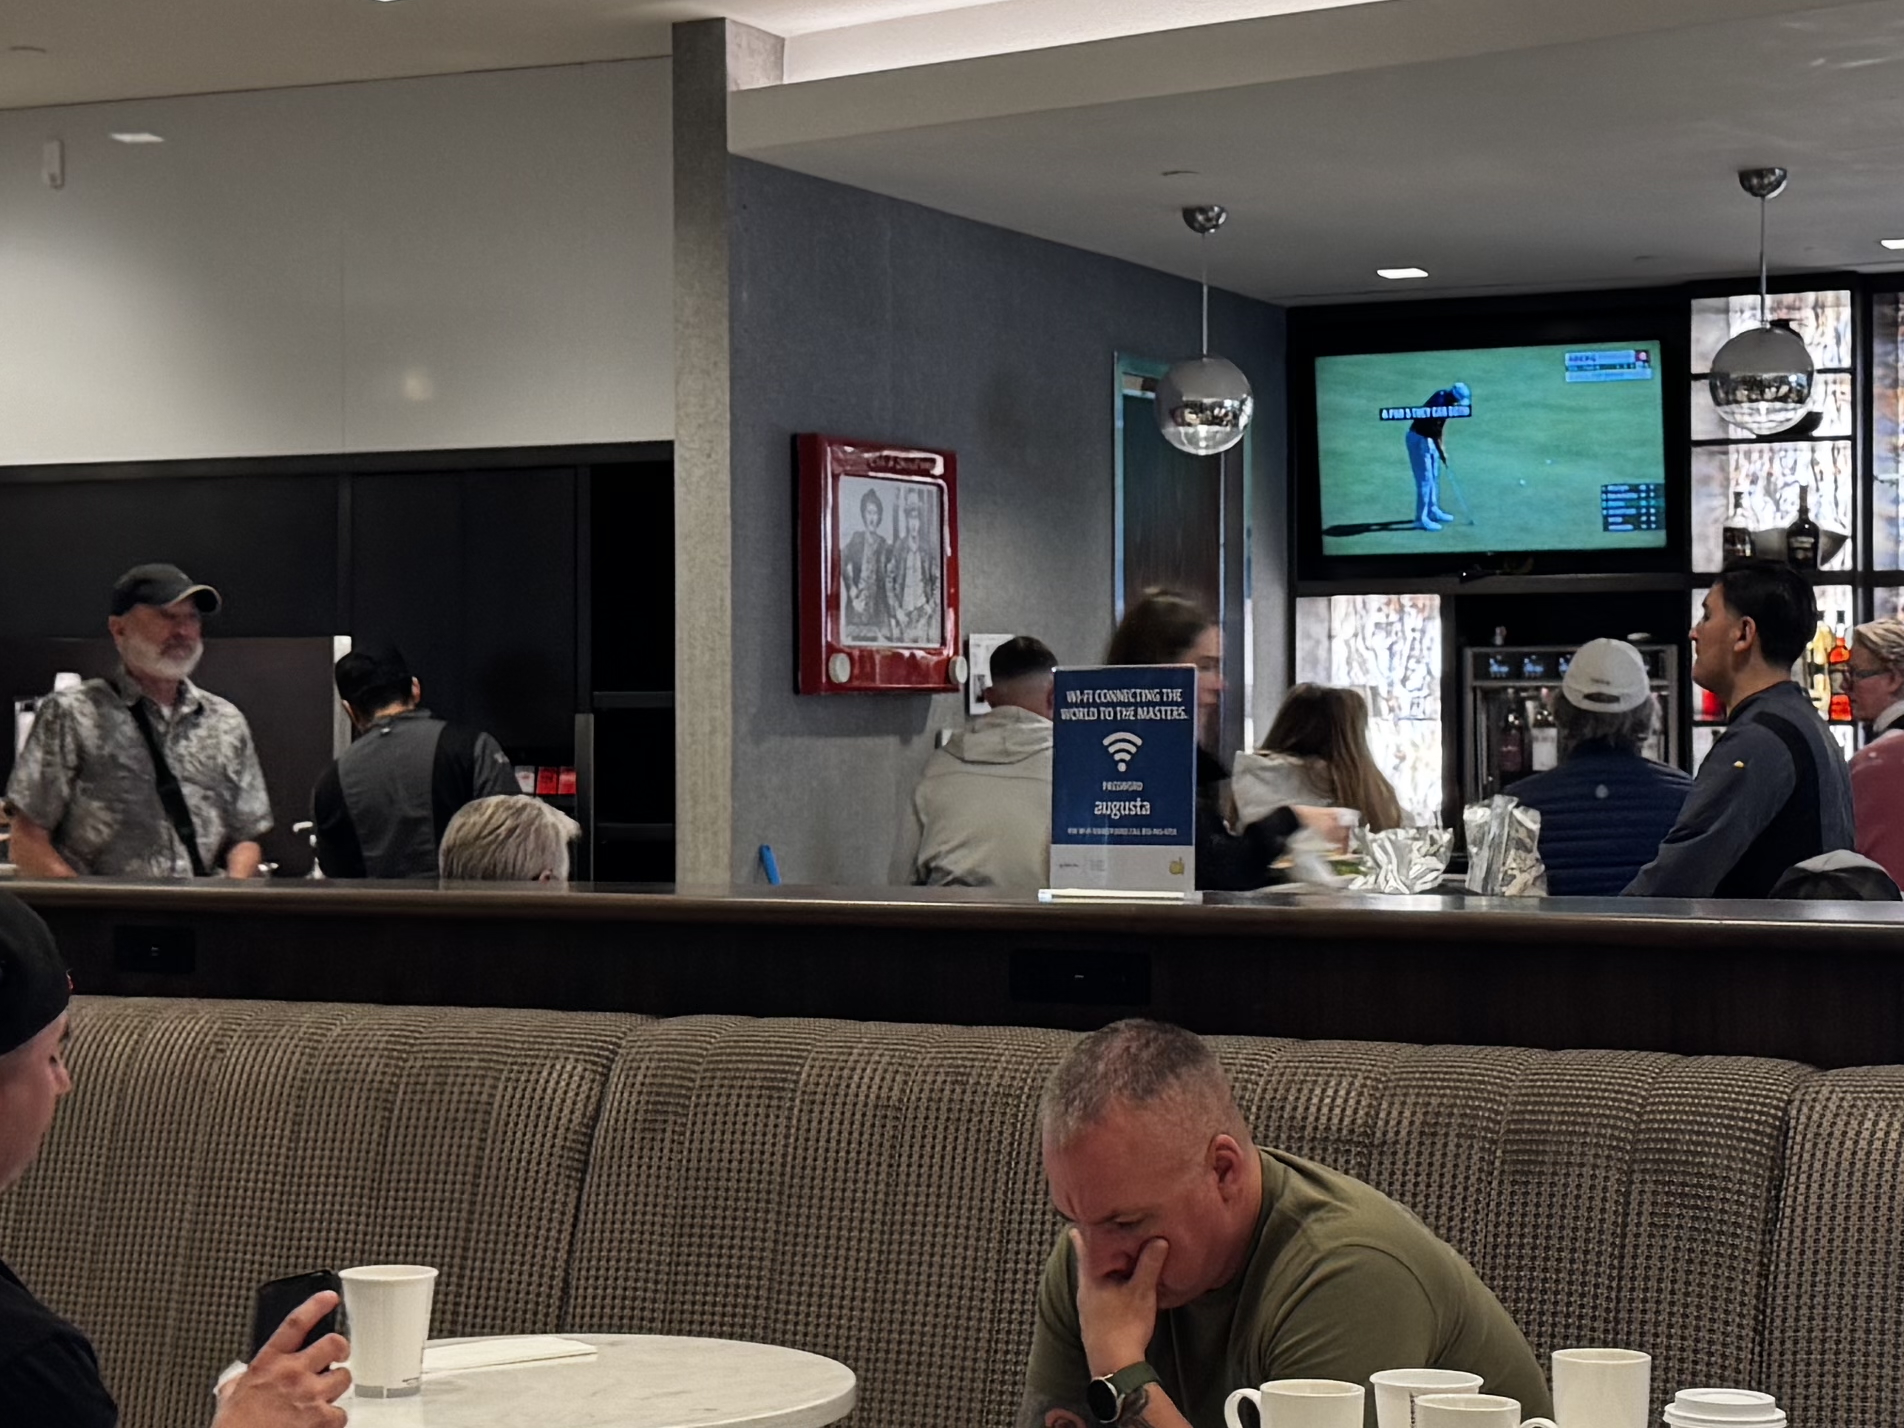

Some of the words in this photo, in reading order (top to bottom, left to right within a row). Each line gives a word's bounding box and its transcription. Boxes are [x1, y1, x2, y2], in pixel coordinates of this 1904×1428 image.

[1162, 688, 1183, 702] THE
[1100, 707, 1114, 720] TO
[1116, 707, 1135, 720] THE
[1094, 798, 1151, 819] augusta
